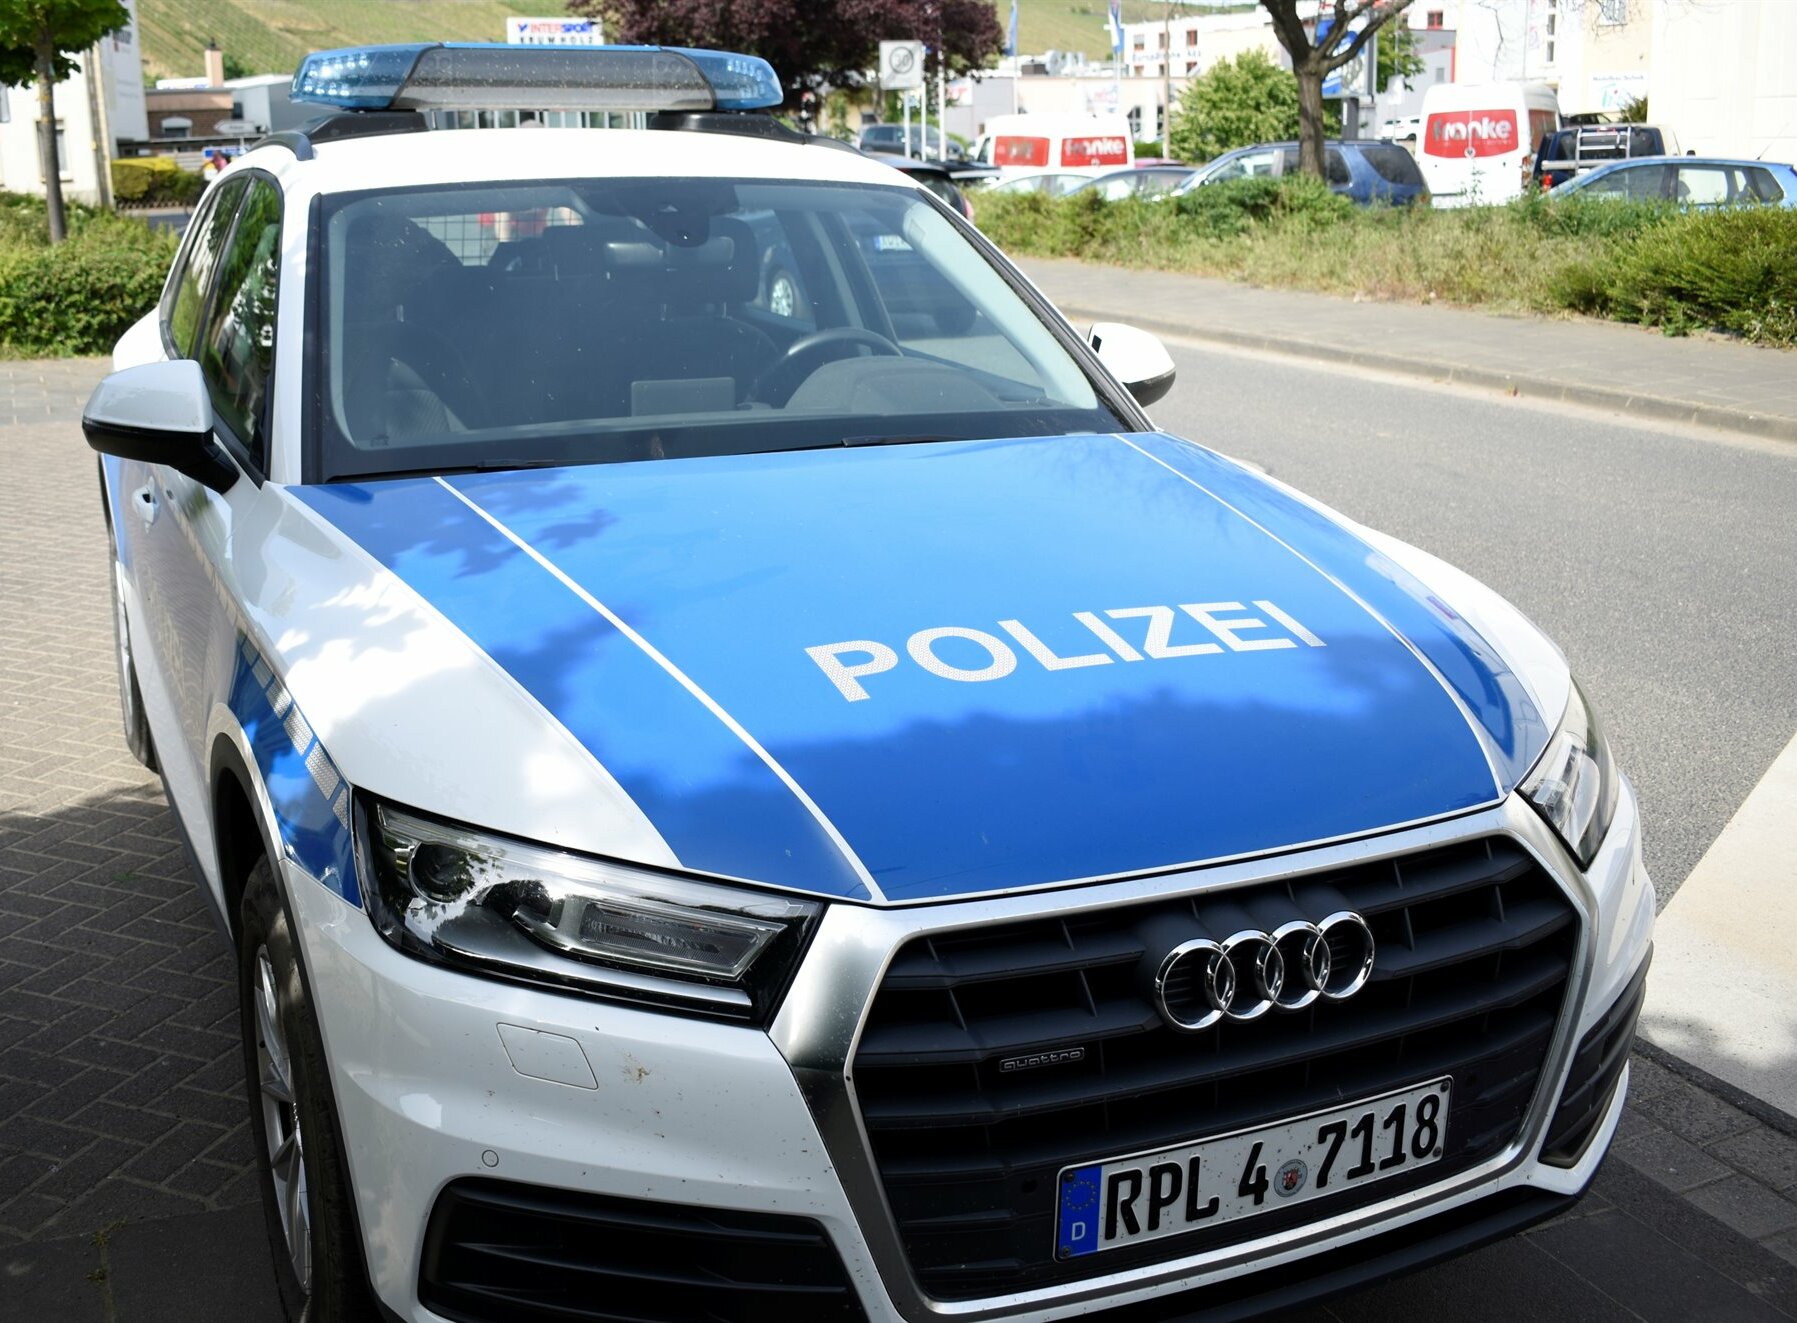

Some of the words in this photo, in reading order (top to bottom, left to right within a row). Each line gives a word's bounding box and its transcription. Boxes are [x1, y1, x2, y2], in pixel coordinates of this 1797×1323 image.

[803, 600, 1328, 703] POLIZEI
[1003, 1049, 1082, 1070] quattro
[1104, 1154, 1220, 1241] RPL
[1238, 1141, 1269, 1206] 4
[1315, 1093, 1441, 1189] 7118
[1070, 1221, 1087, 1241] D
